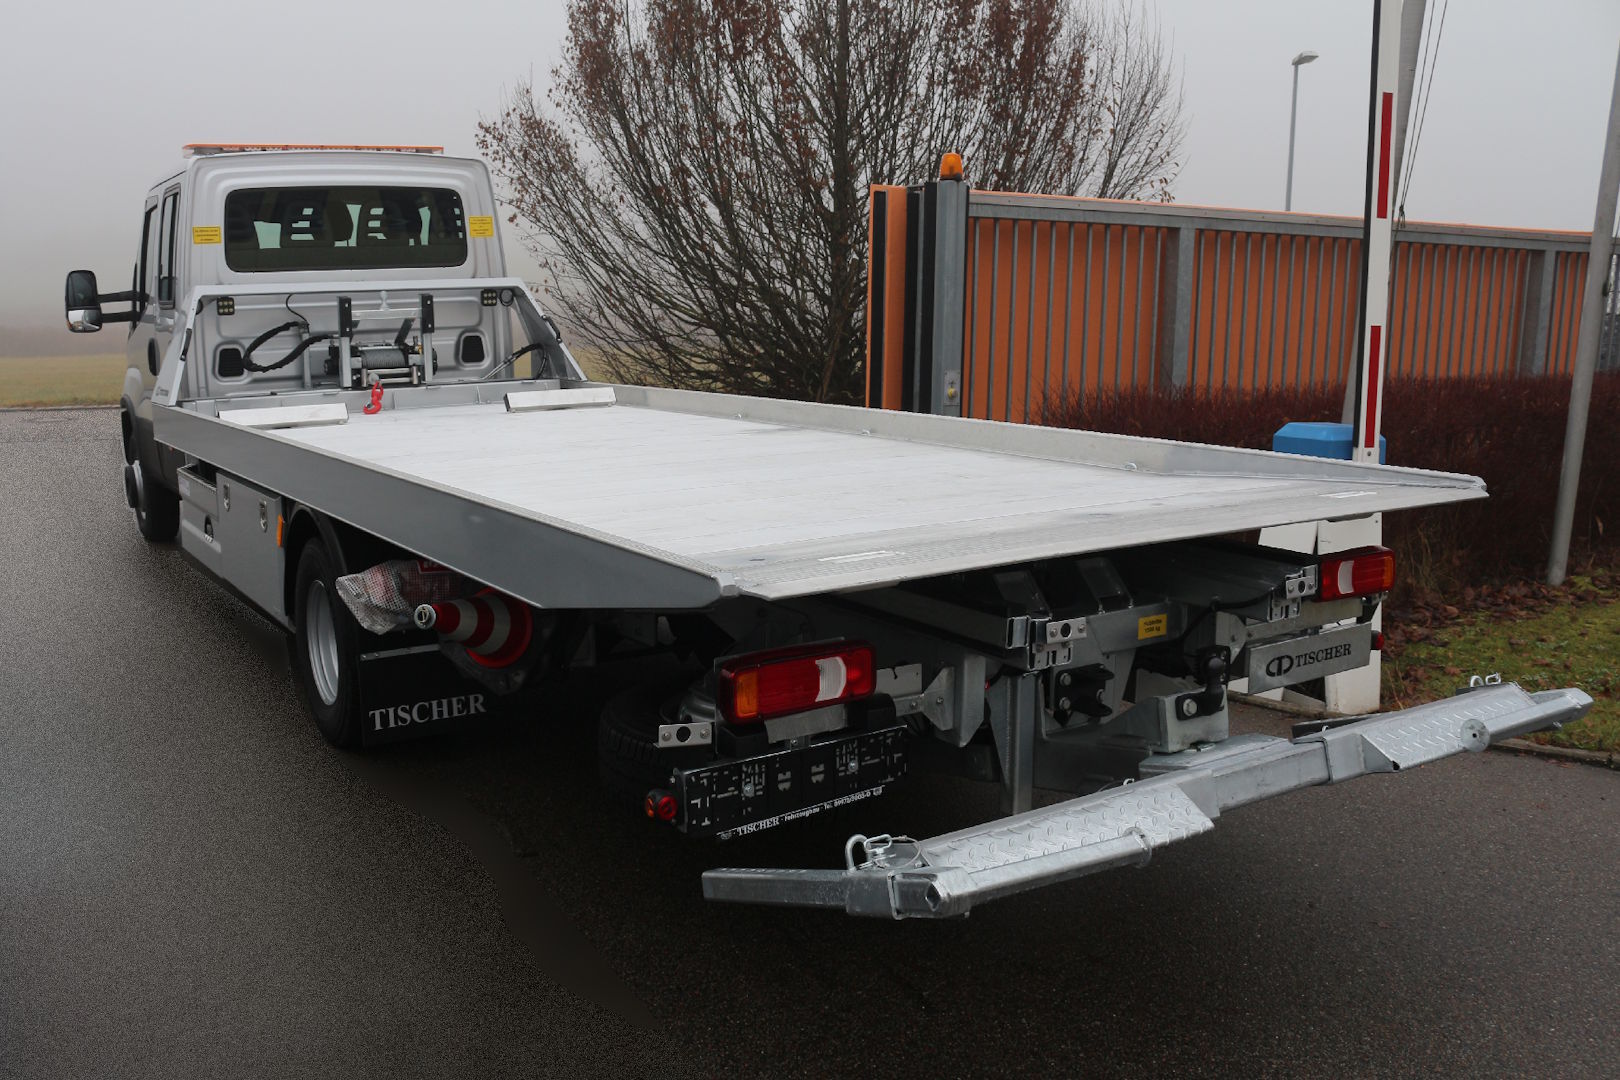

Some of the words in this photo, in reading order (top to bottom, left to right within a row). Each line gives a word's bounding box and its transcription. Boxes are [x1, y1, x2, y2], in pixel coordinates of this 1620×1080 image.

[1295, 643, 1352, 668] TISCHER
[368, 693, 487, 731] TISCHER
[737, 816, 780, 836] TISCHER
